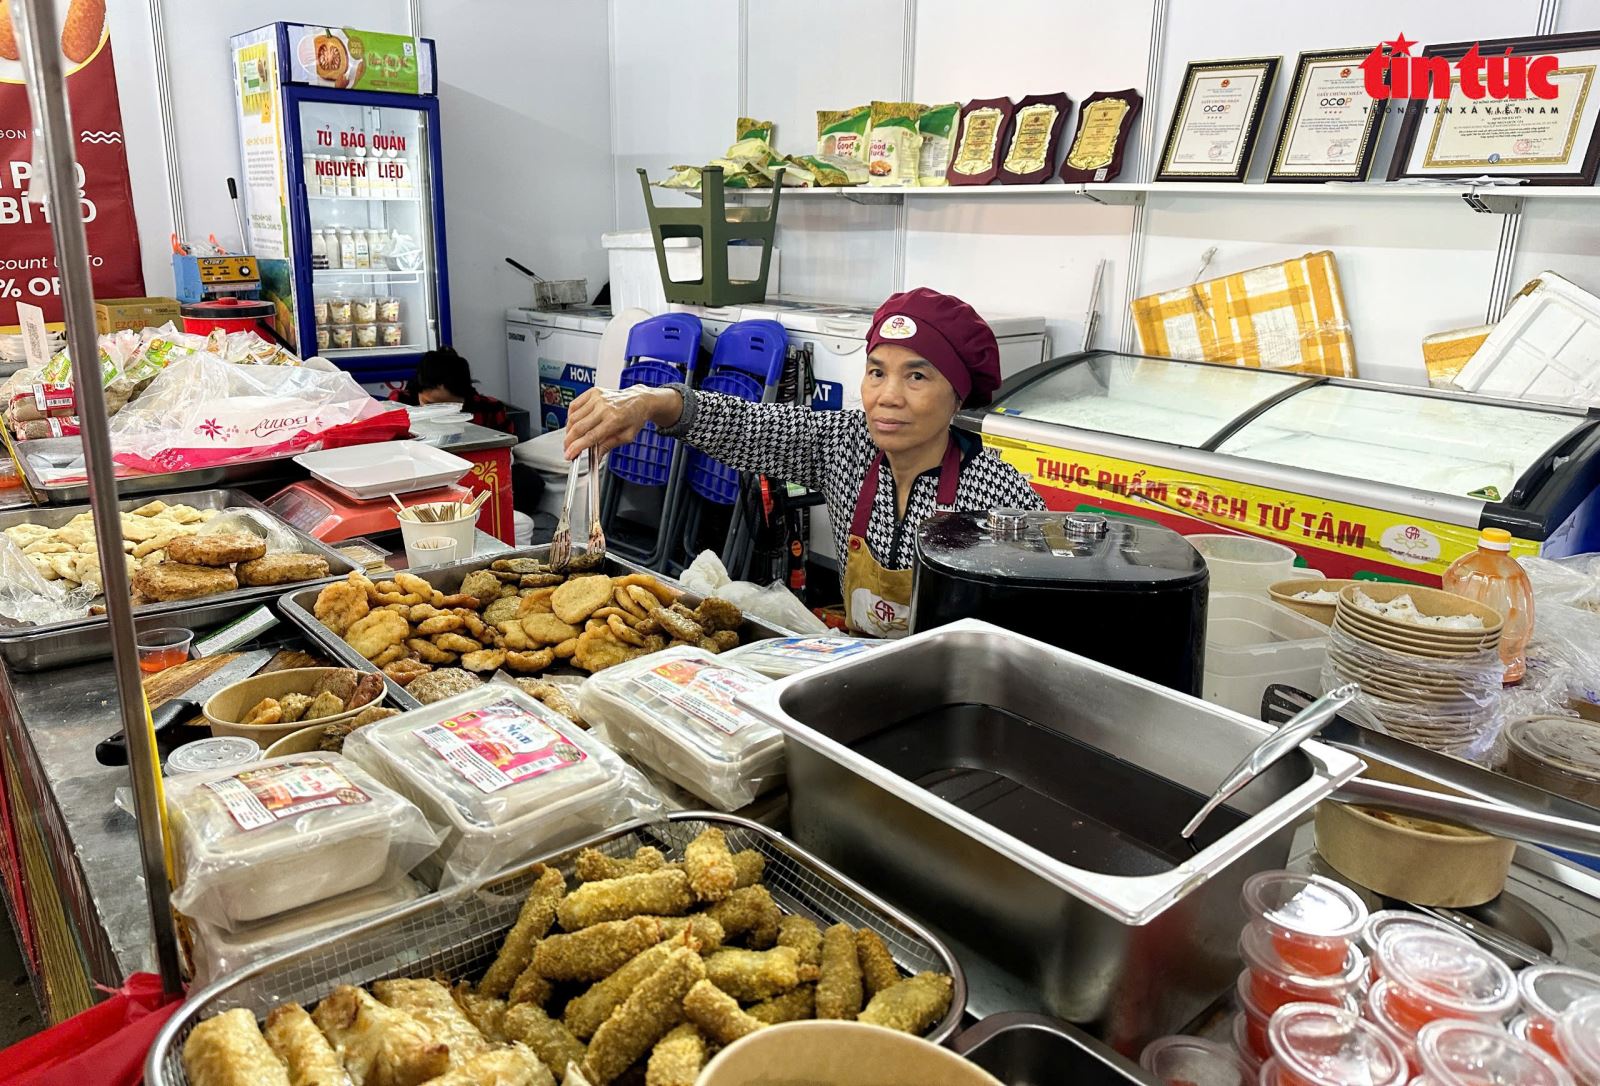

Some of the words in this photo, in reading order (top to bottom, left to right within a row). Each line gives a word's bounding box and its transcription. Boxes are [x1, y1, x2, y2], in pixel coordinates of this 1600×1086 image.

[1203, 104, 1231, 113] OCOP
[1320, 97, 1352, 107] OCOP
[316, 124, 332, 147] TỦ
[340, 126, 366, 149] BẢO
[372, 130, 406, 152] QUẢN
[315, 158, 366, 178] NGUYÊN
[378, 160, 404, 182] LIỆU
[1036, 457, 1090, 488] THỰC
[1096, 469, 1168, 502] PHẨM
[1176, 486, 1248, 522] SẠCH
[1257, 501, 1296, 531] TỪ
[1301, 511, 1367, 549] TÂM
